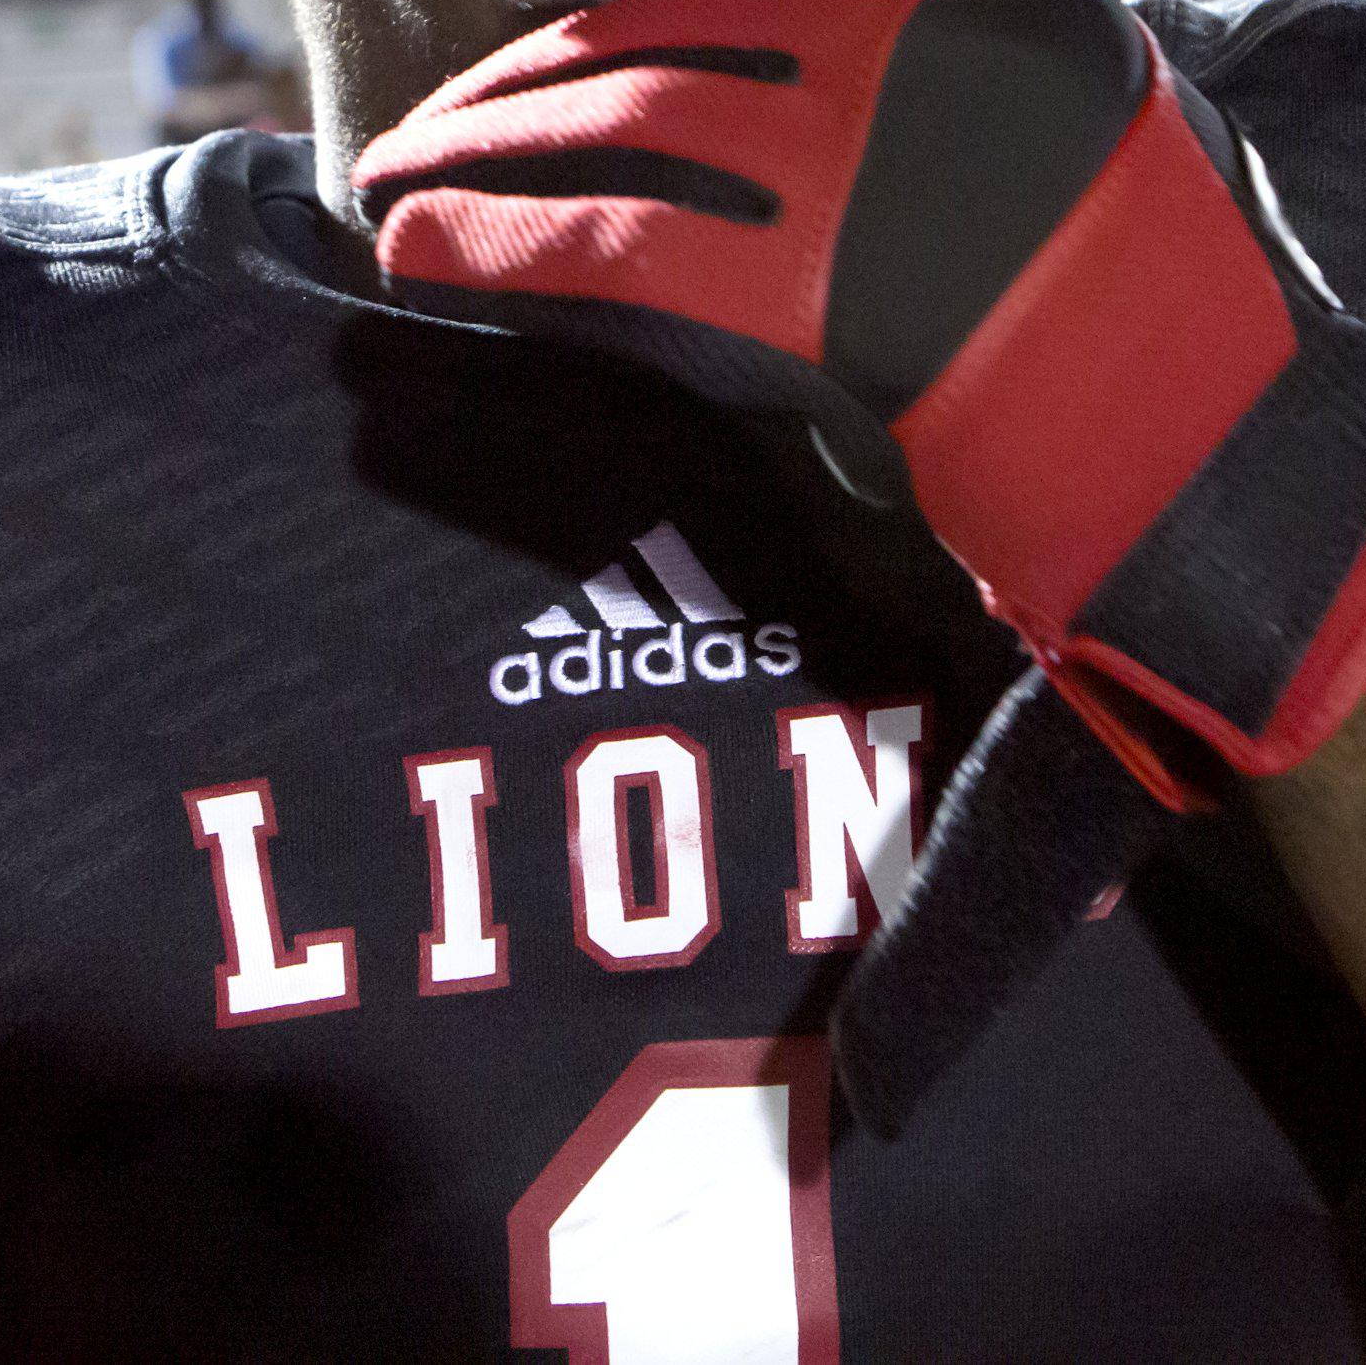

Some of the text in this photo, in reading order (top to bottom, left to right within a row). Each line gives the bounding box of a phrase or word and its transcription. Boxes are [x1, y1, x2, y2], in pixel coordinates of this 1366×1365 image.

[489, 622, 802, 706] adidas
[183, 702, 1123, 1029] LION
[507, 1036, 841, 1365] 1
